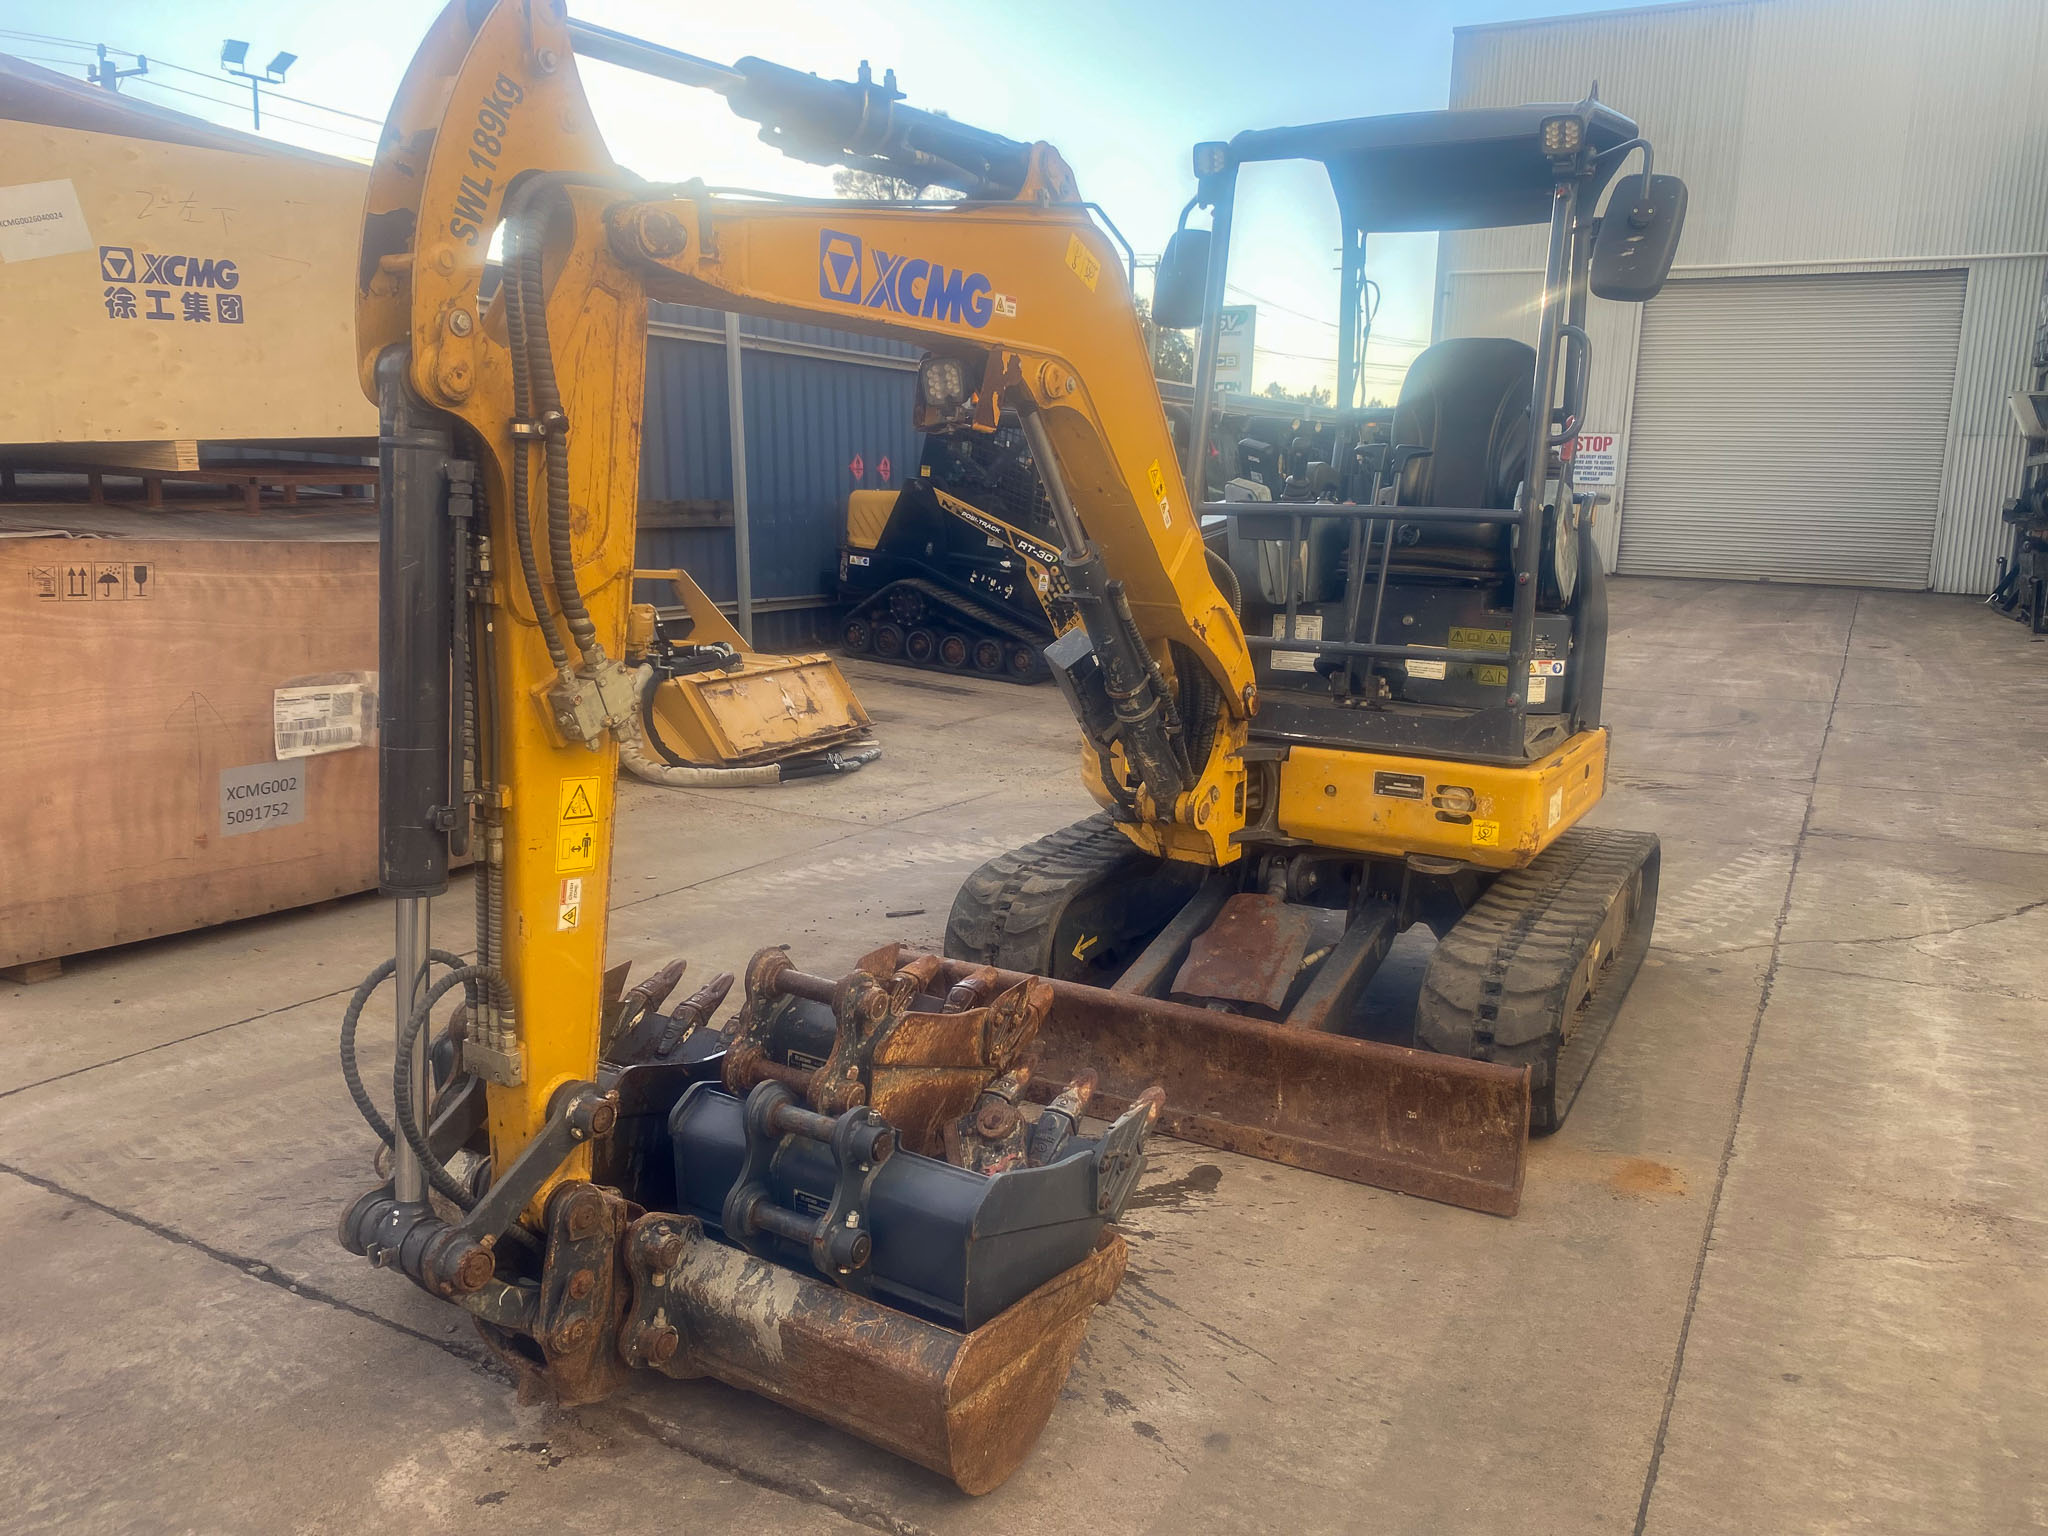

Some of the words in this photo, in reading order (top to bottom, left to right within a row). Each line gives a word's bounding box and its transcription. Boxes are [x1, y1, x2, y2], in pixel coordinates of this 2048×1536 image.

[468, 71, 524, 174] 189kg
[451, 174, 493, 247] SWL
[138, 252, 239, 290] XCMG
[861, 248, 993, 329] XCMG
[103, 286, 244, 324] 徐工集团
[1216, 356, 1237, 368] CB
[1577, 436, 1613, 452] STOP
[961, 511, 1001, 533] POSI-TRACK
[1017, 540, 1054, 563] RT-30
[226, 777, 297, 801] XCMG002
[226, 802, 289, 825] 5091752
